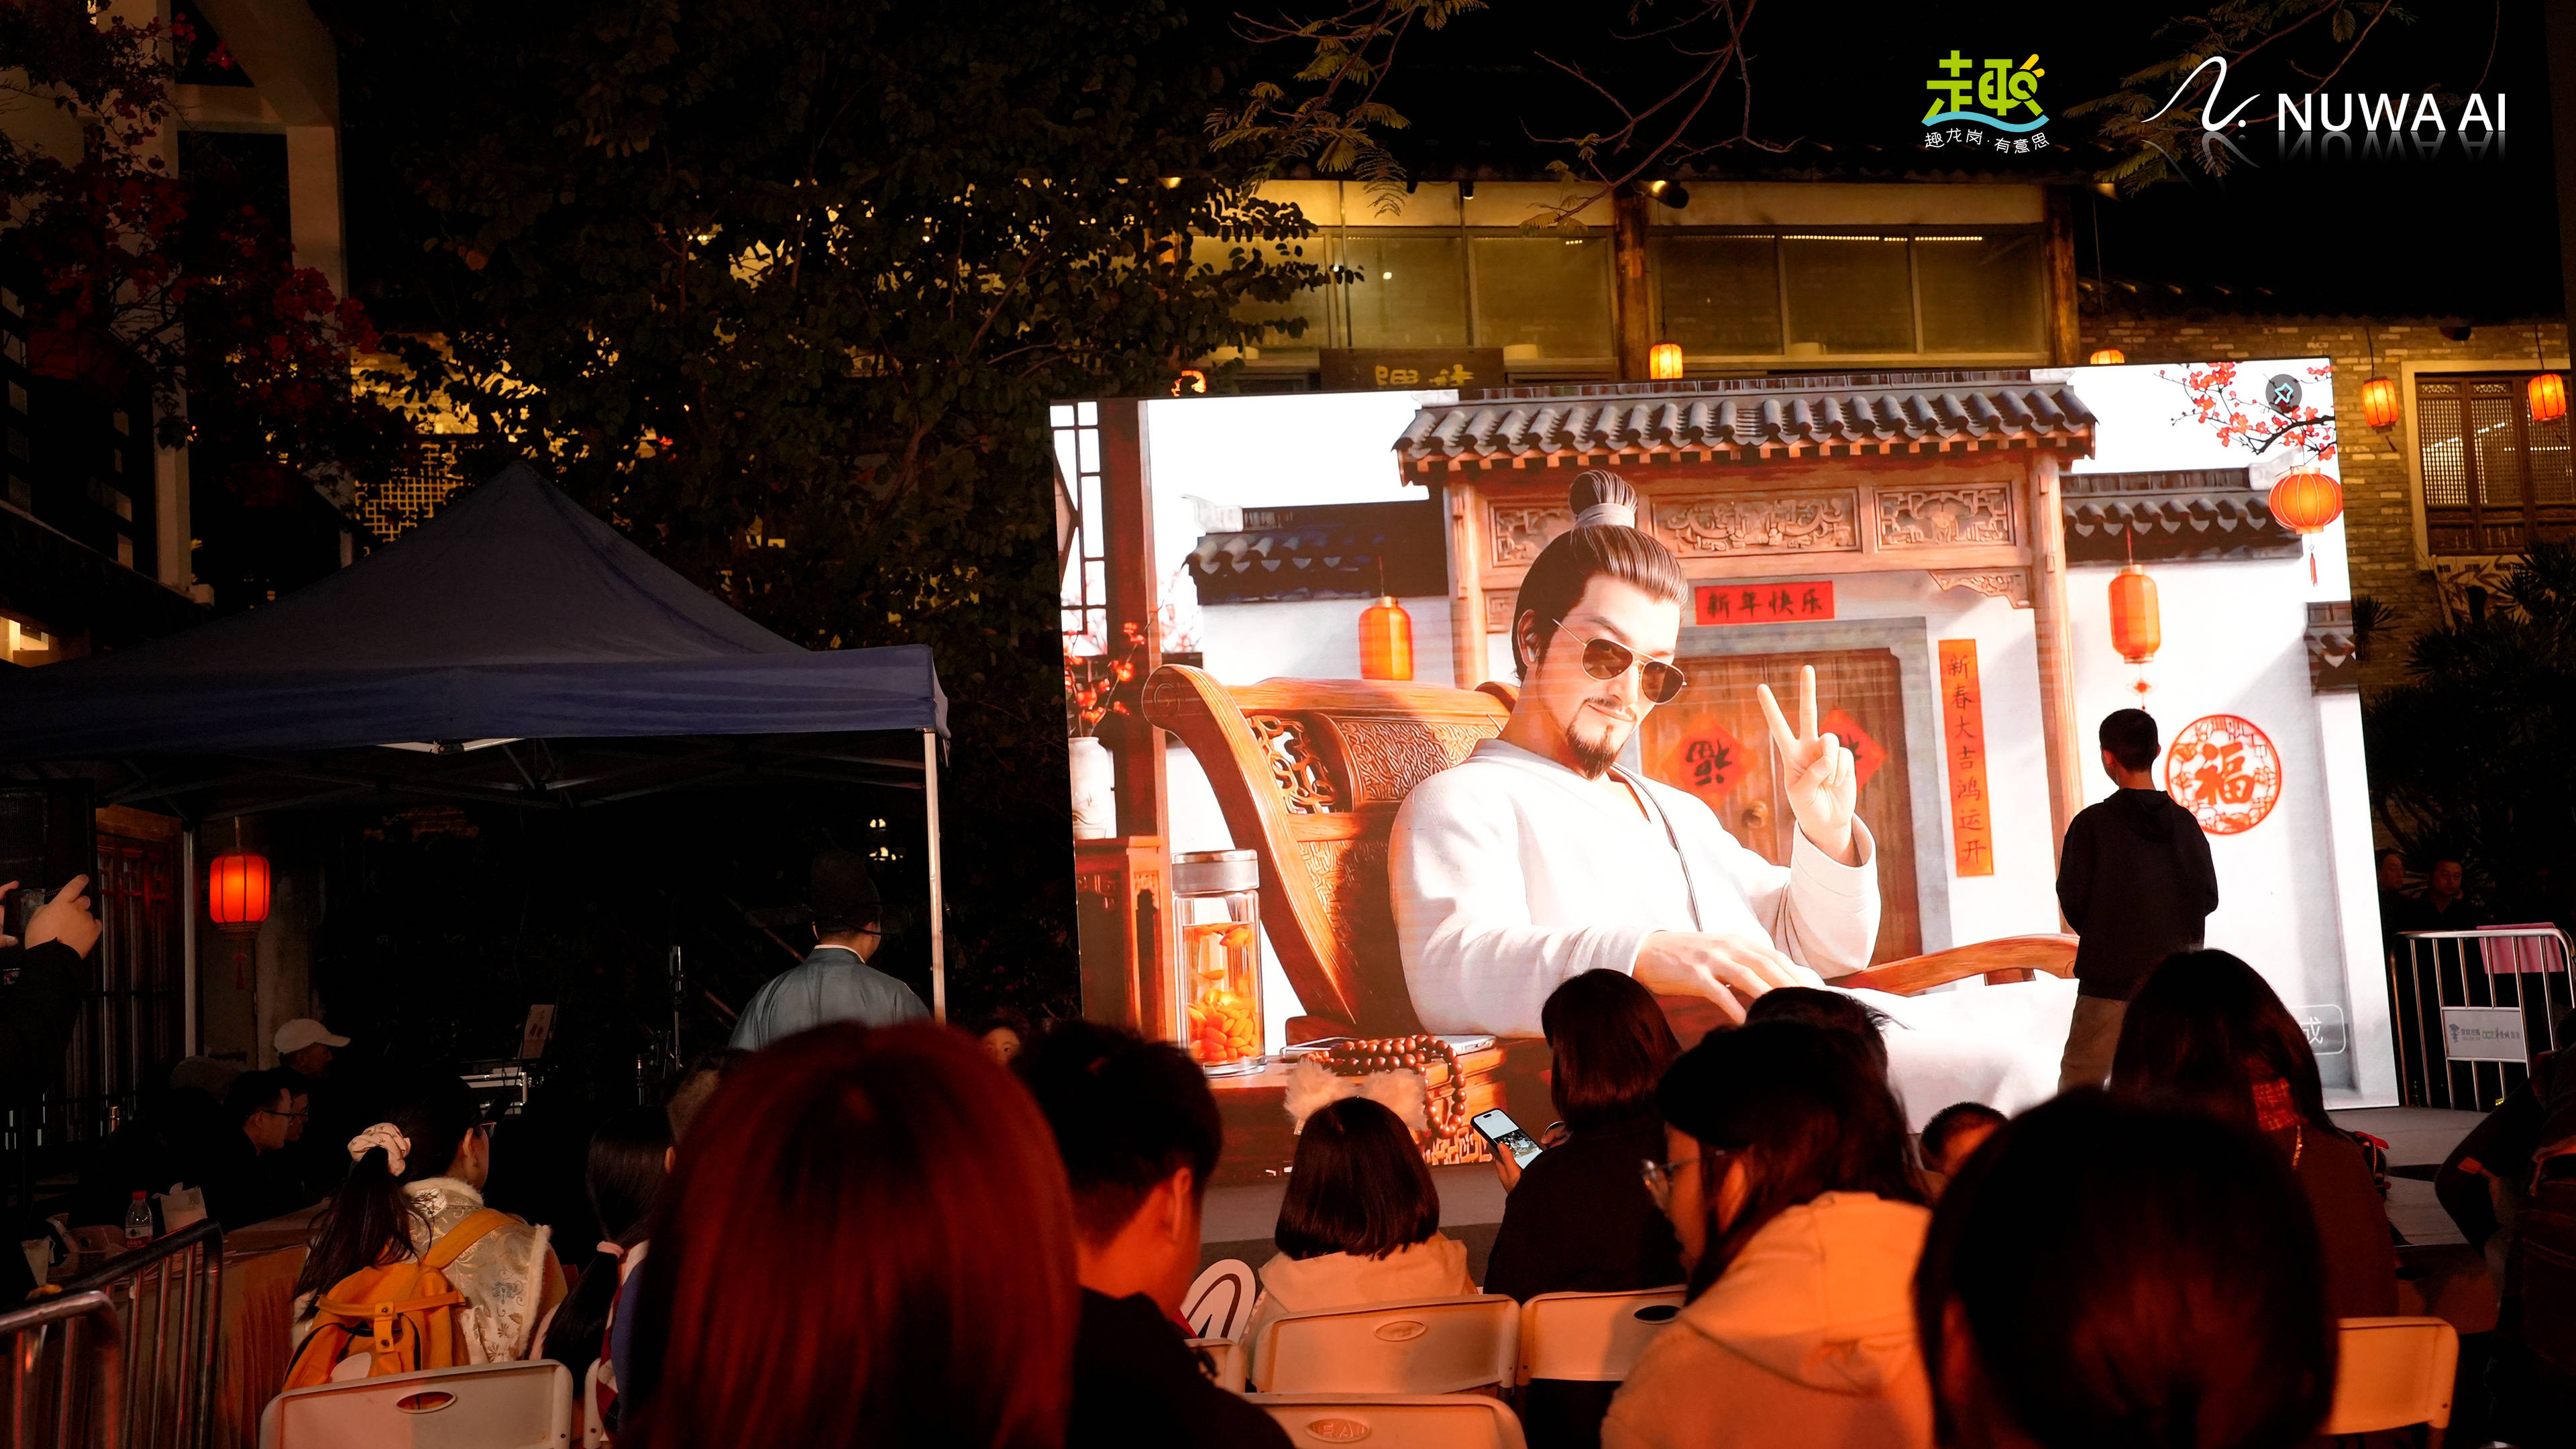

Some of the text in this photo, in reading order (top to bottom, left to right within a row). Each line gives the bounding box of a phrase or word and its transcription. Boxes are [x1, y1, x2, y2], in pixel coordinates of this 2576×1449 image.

[1707, 588, 1823, 618] 新年快乐
[1946, 654, 1986, 865] 新春大吉鸿运开
[2194, 741, 2256, 806] 福
